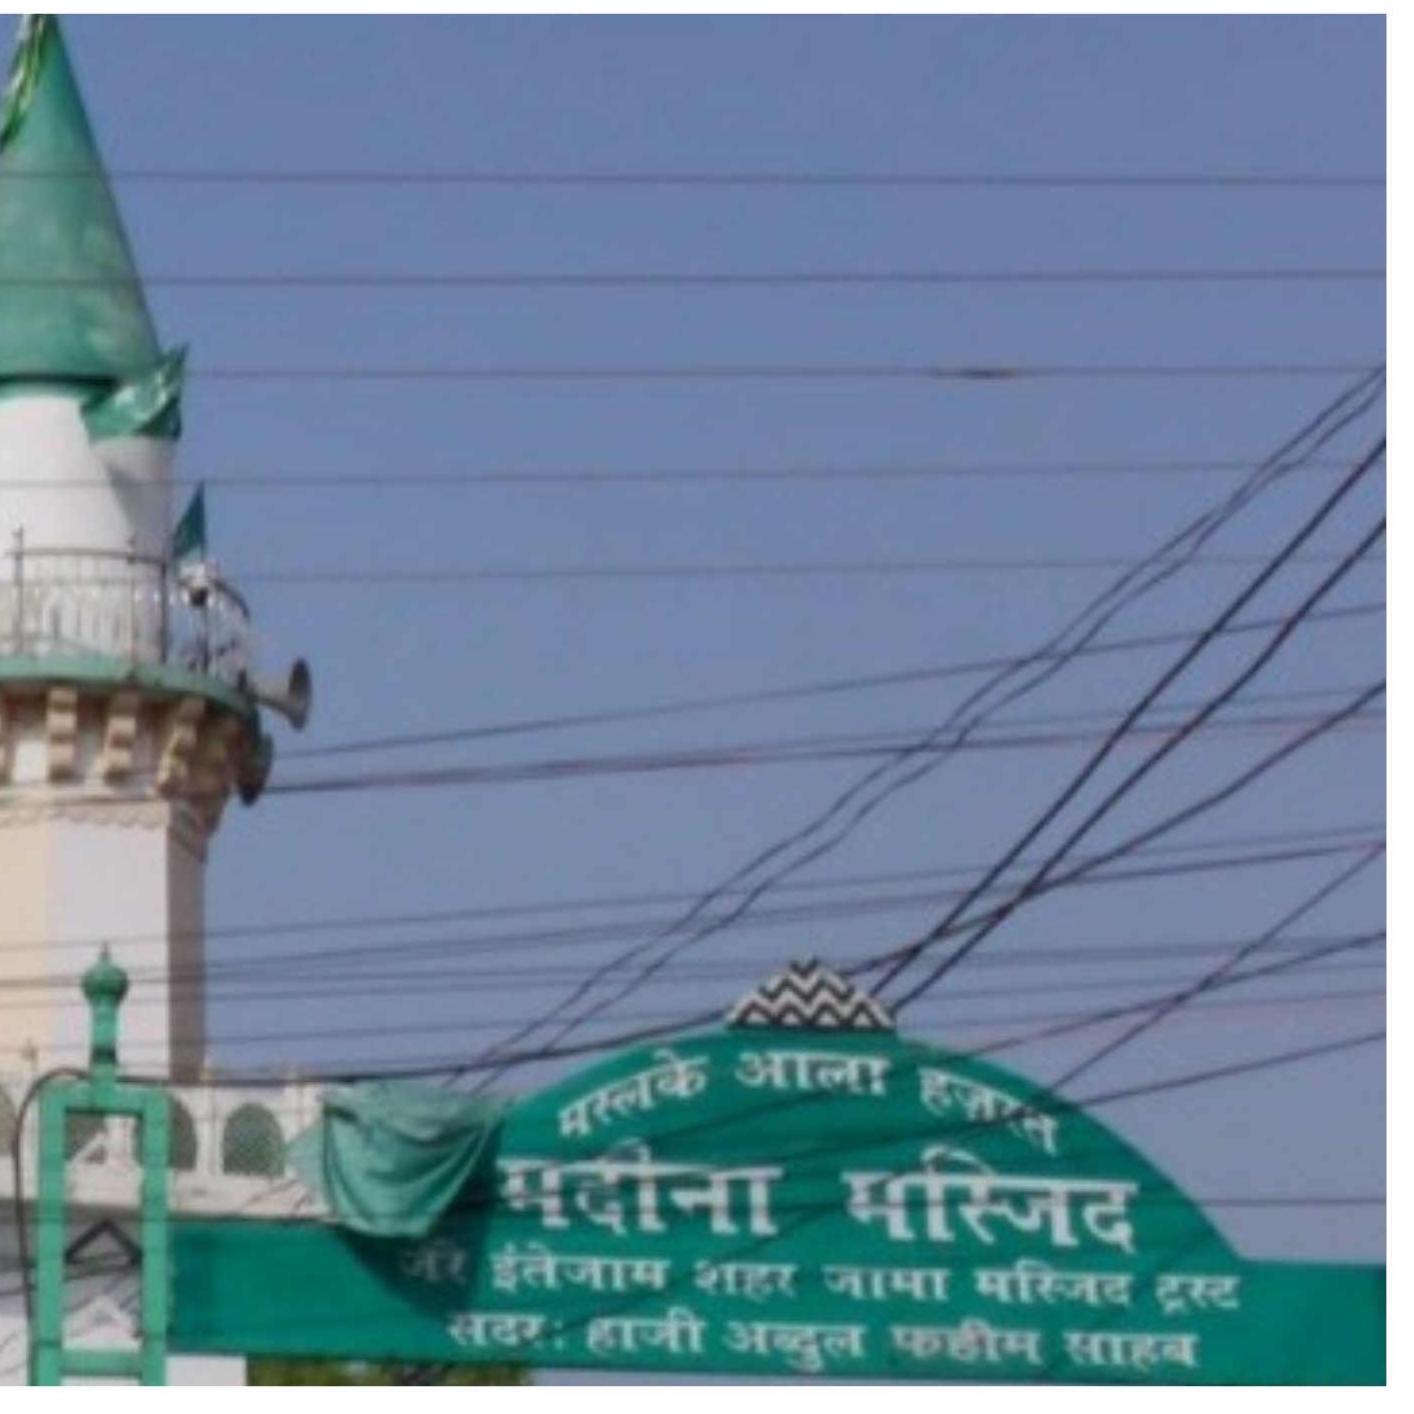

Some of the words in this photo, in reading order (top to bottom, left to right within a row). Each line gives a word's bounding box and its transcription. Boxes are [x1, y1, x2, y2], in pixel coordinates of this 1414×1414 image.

[735, 1049, 890, 1097] आला
[495, 1136, 784, 1237] मदीना
[840, 1144, 1140, 1254] मस्जिद
[694, 1258, 799, 1301] शहर
[820, 1264, 952, 1302] जामा
[973, 1258, 1135, 1308] मस्जिद
[585, 1307, 707, 1356] हाजी
[1063, 1330, 1200, 1372] साहब
